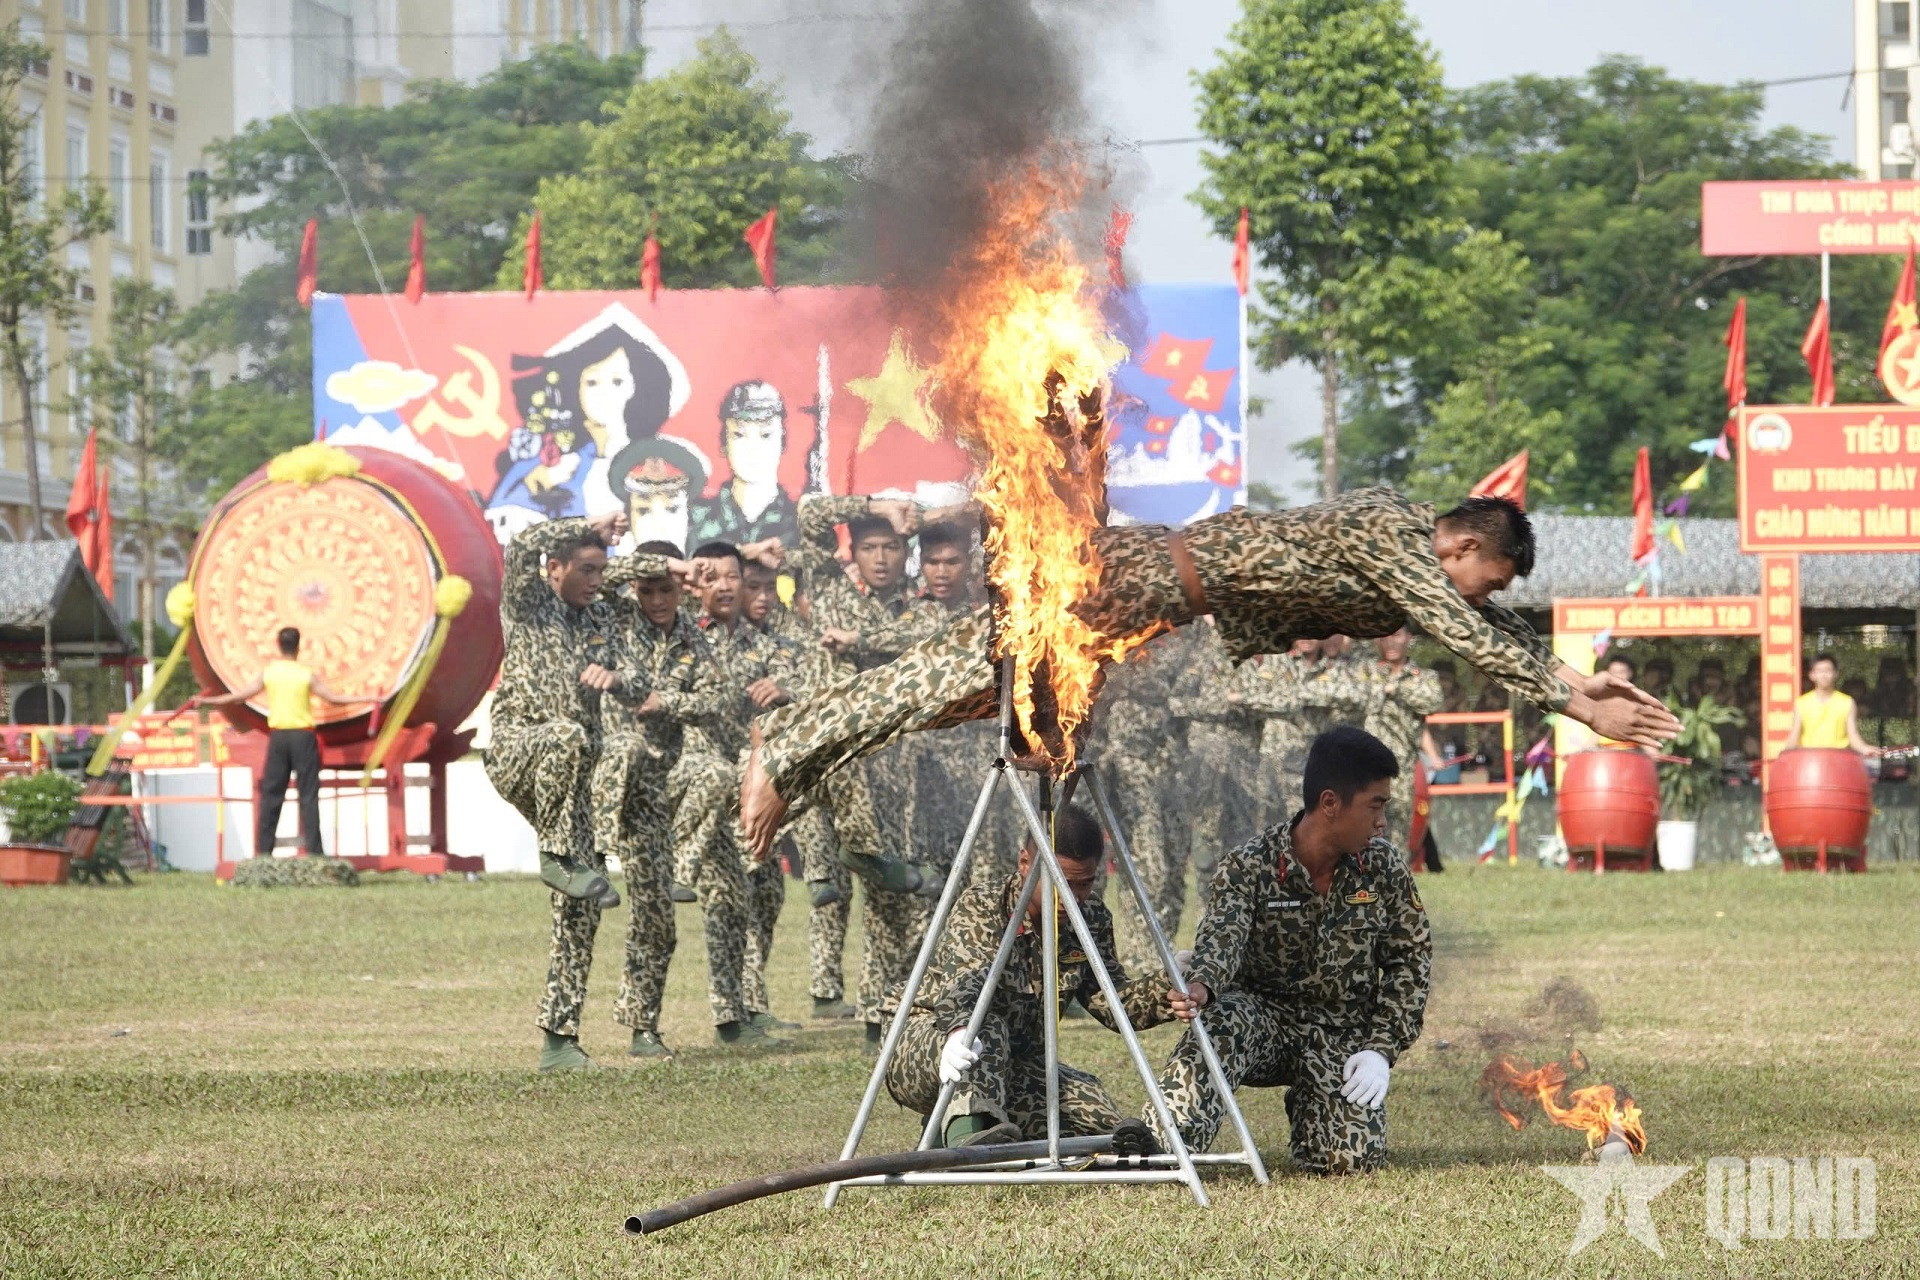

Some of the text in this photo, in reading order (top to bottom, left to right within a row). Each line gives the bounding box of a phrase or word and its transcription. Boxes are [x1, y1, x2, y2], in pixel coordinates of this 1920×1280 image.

[1843, 414, 1900, 454] TIỂU
[1773, 467, 1812, 492] KHU
[1880, 462, 1918, 491] BÀY
[1755, 503, 1804, 538] CHÀO
[1807, 503, 1862, 537] MỪNG
[1864, 503, 1907, 537] NĂM
[1716, 606, 1752, 630] TẠO
